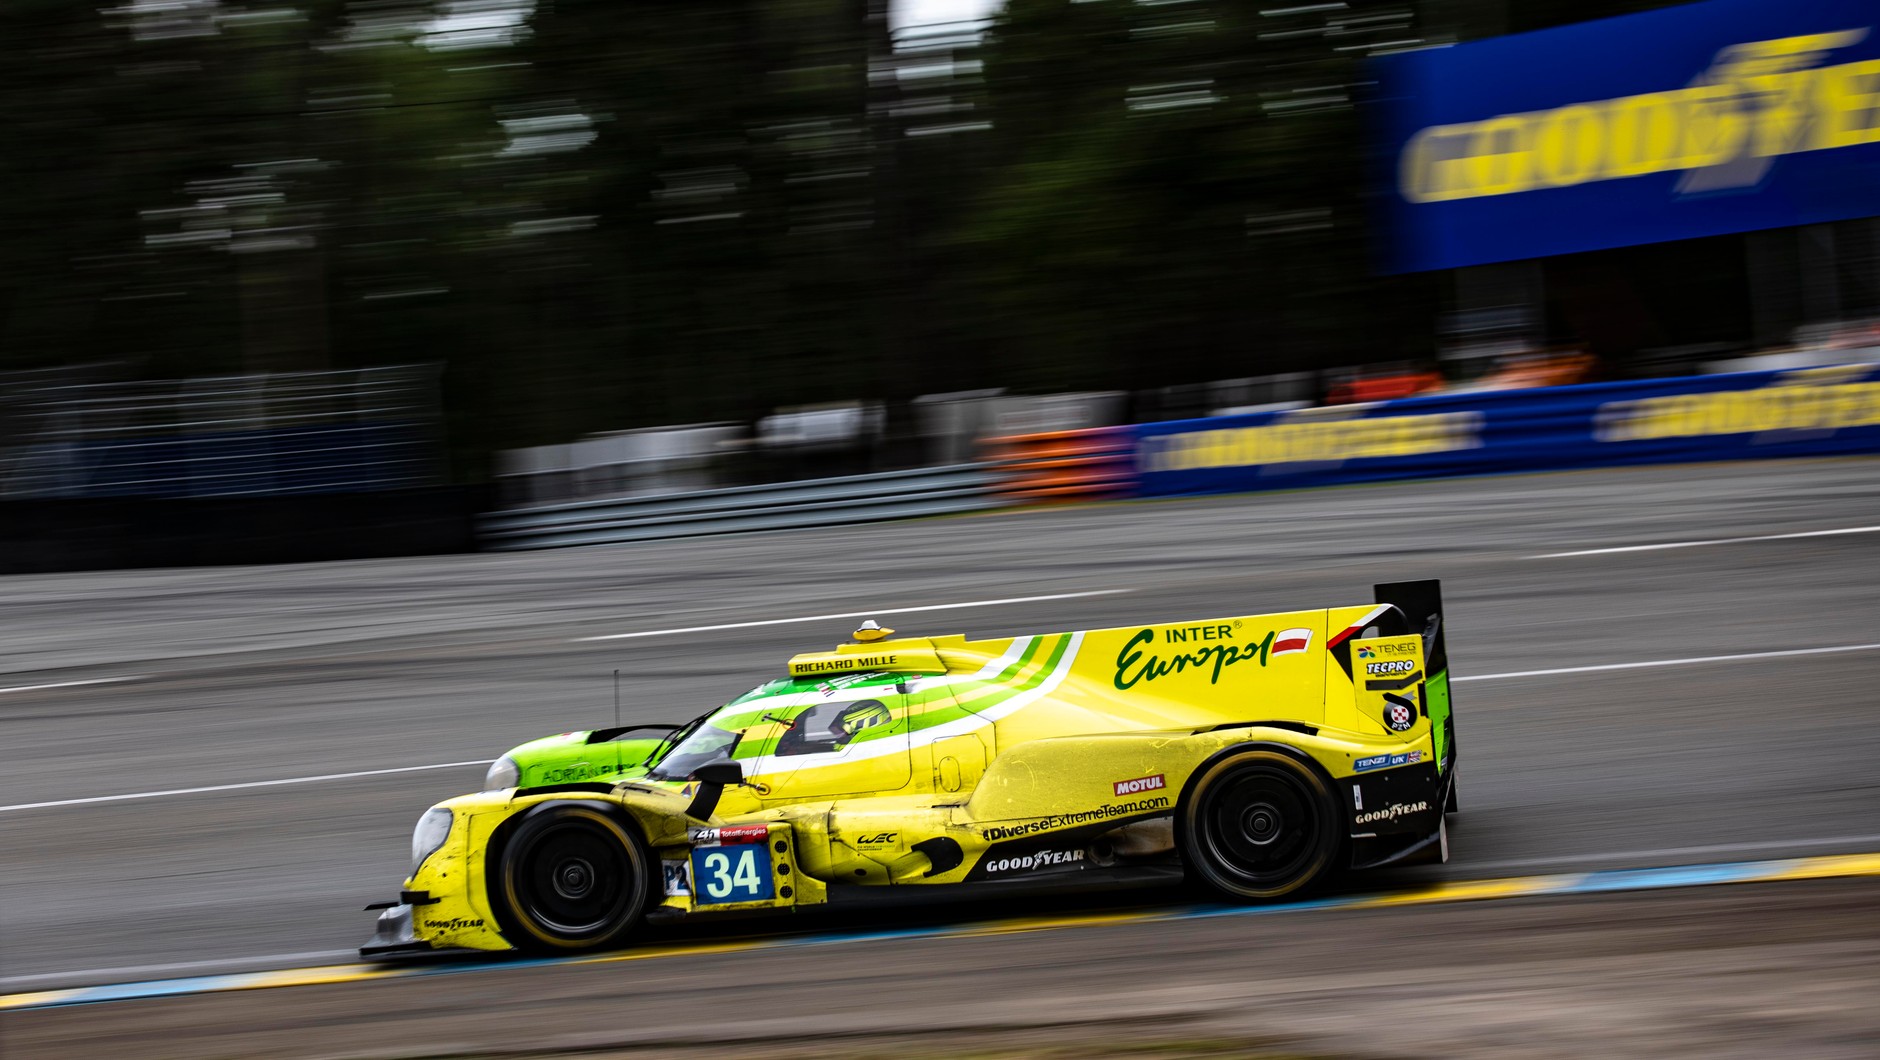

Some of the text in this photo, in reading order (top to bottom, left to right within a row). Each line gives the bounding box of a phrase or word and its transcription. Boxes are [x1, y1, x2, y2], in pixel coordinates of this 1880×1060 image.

[1166, 625, 1233, 643] INTER
[1377, 642, 1416, 653] TENEG
[795, 655, 897, 673] RICHARD MILLE
[1114, 629, 1275, 690] Europol
[1367, 660, 1414, 674] TECPRO
[1391, 722, 1411, 731] PZM
[1357, 756, 1405, 767] TENZI UK
[1116, 776, 1162, 795] MOTUL
[990, 796, 1169, 841] DiverseExtremeTeam.com
[1355, 801, 1427, 824] GOODYEAR
[721, 827, 766, 838] TotalEnergies
[857, 832, 898, 844] WEC
[986, 849, 1085, 872] GOODYEAR
[664, 864, 689, 891] P2
[704, 849, 761, 898] 34
[423, 918, 484, 931] GOODYEAR
